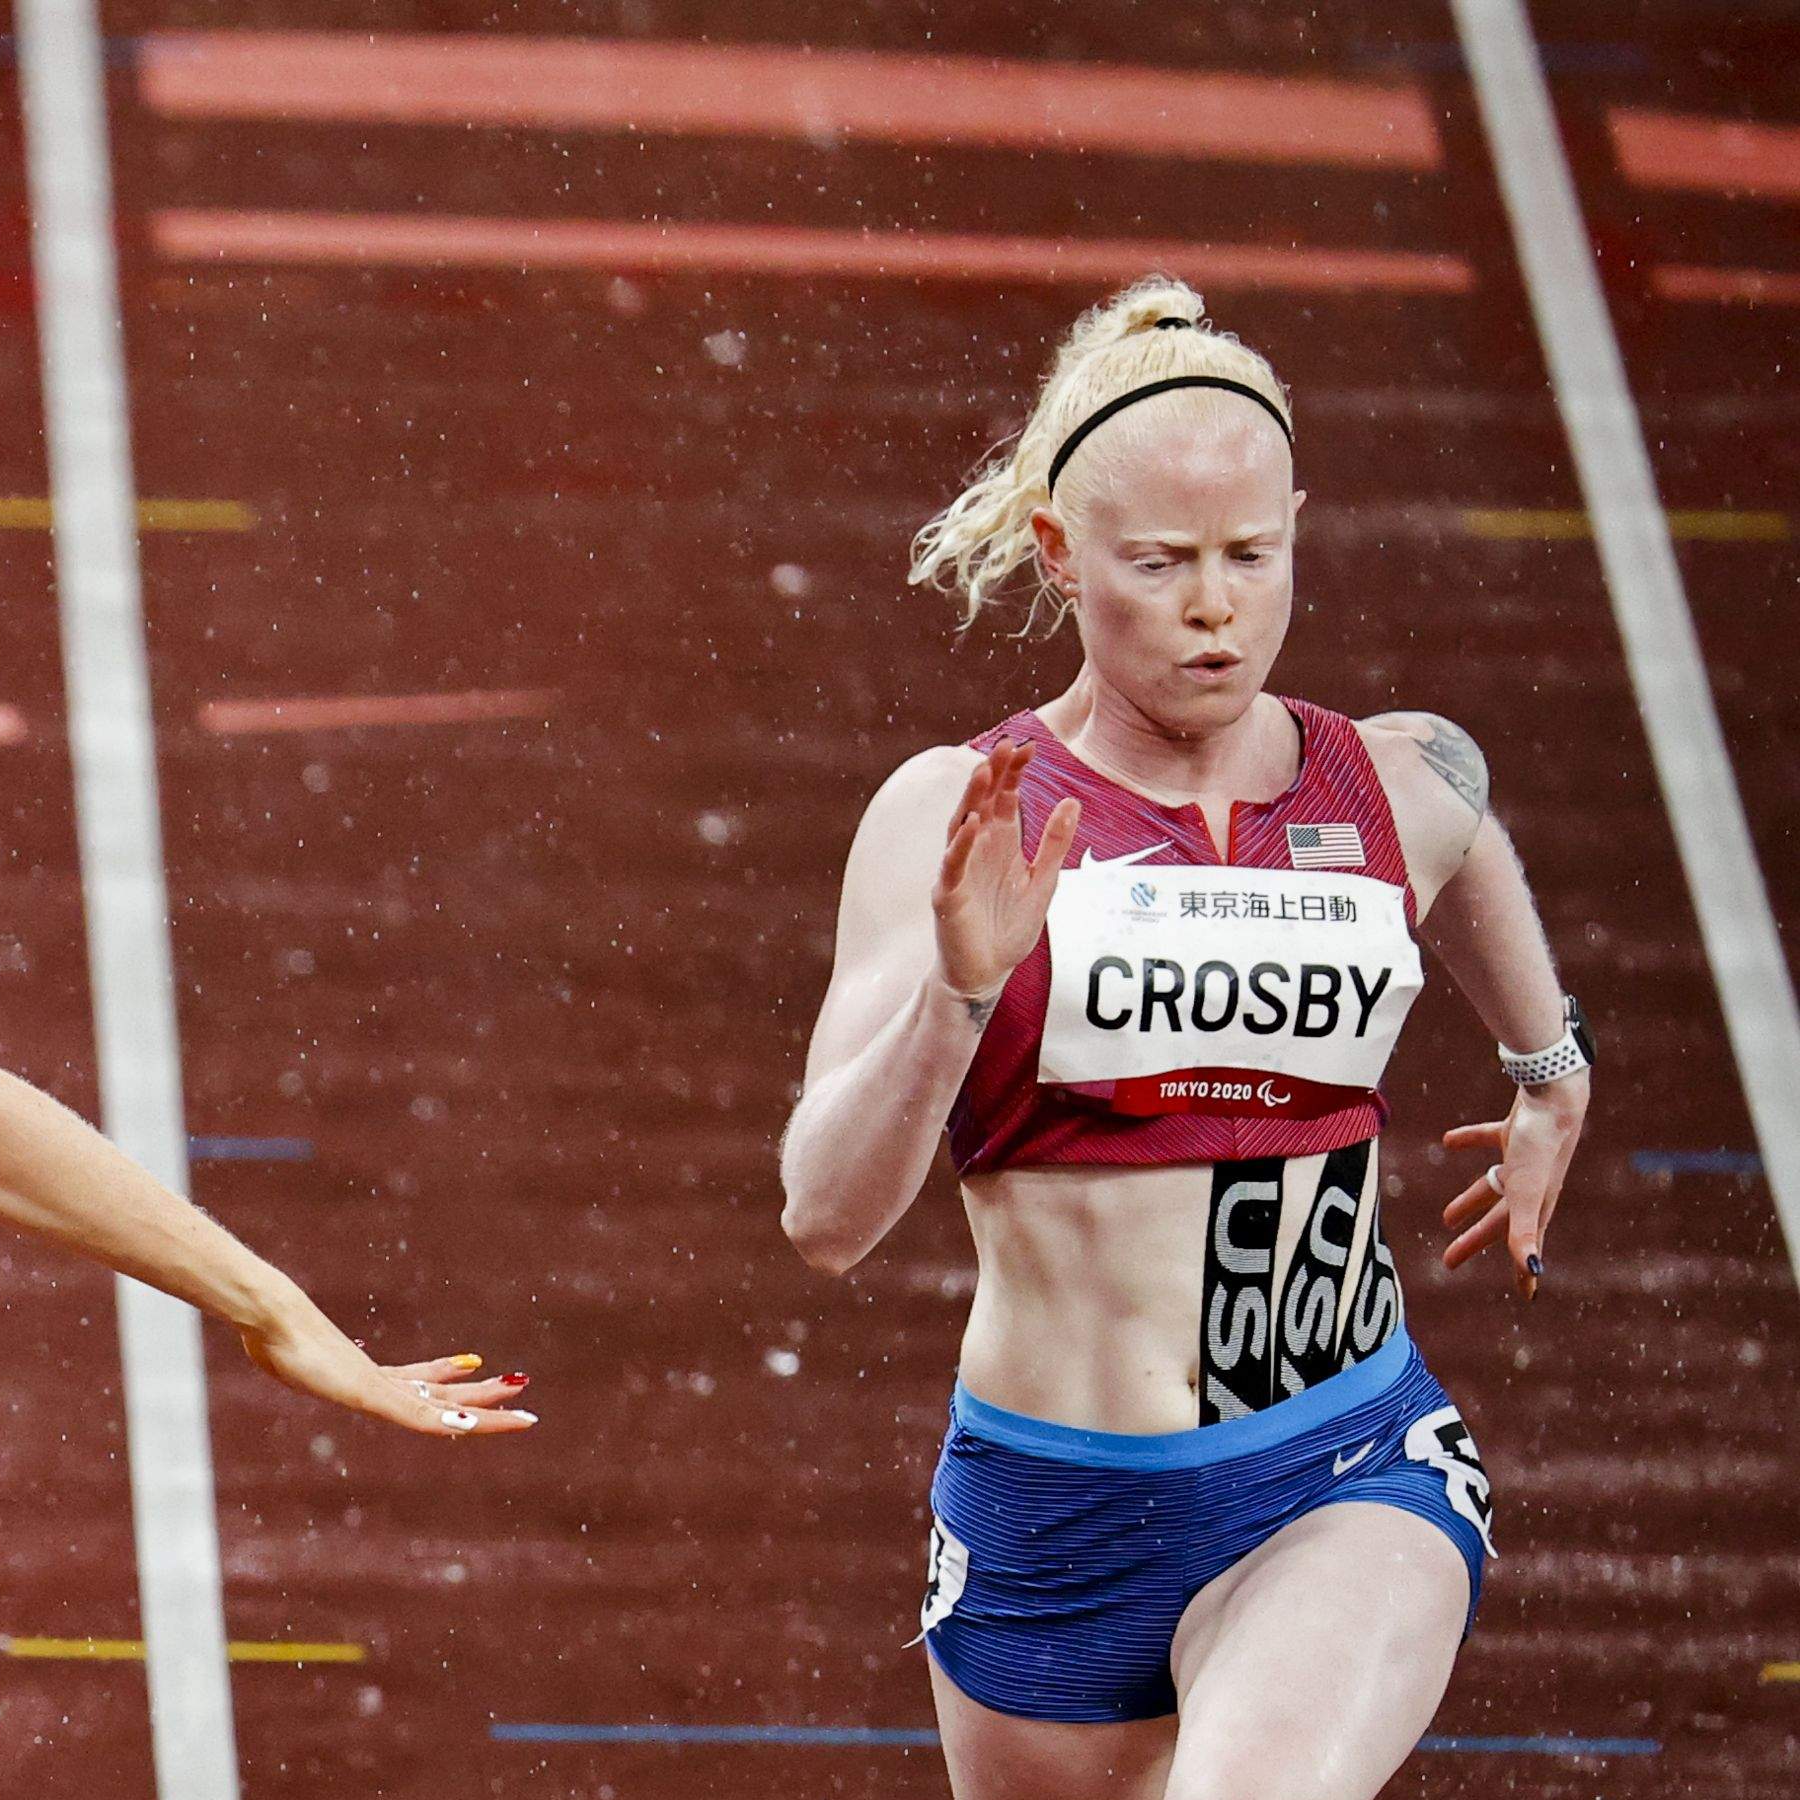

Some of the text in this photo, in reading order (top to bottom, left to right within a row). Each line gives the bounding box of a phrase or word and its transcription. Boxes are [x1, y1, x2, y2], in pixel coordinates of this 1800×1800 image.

[1178, 891, 1357, 923] 東京海上日動
[1086, 956, 1392, 1038] CROSBY
[1160, 1081, 1252, 1100] TOKYO 2020
